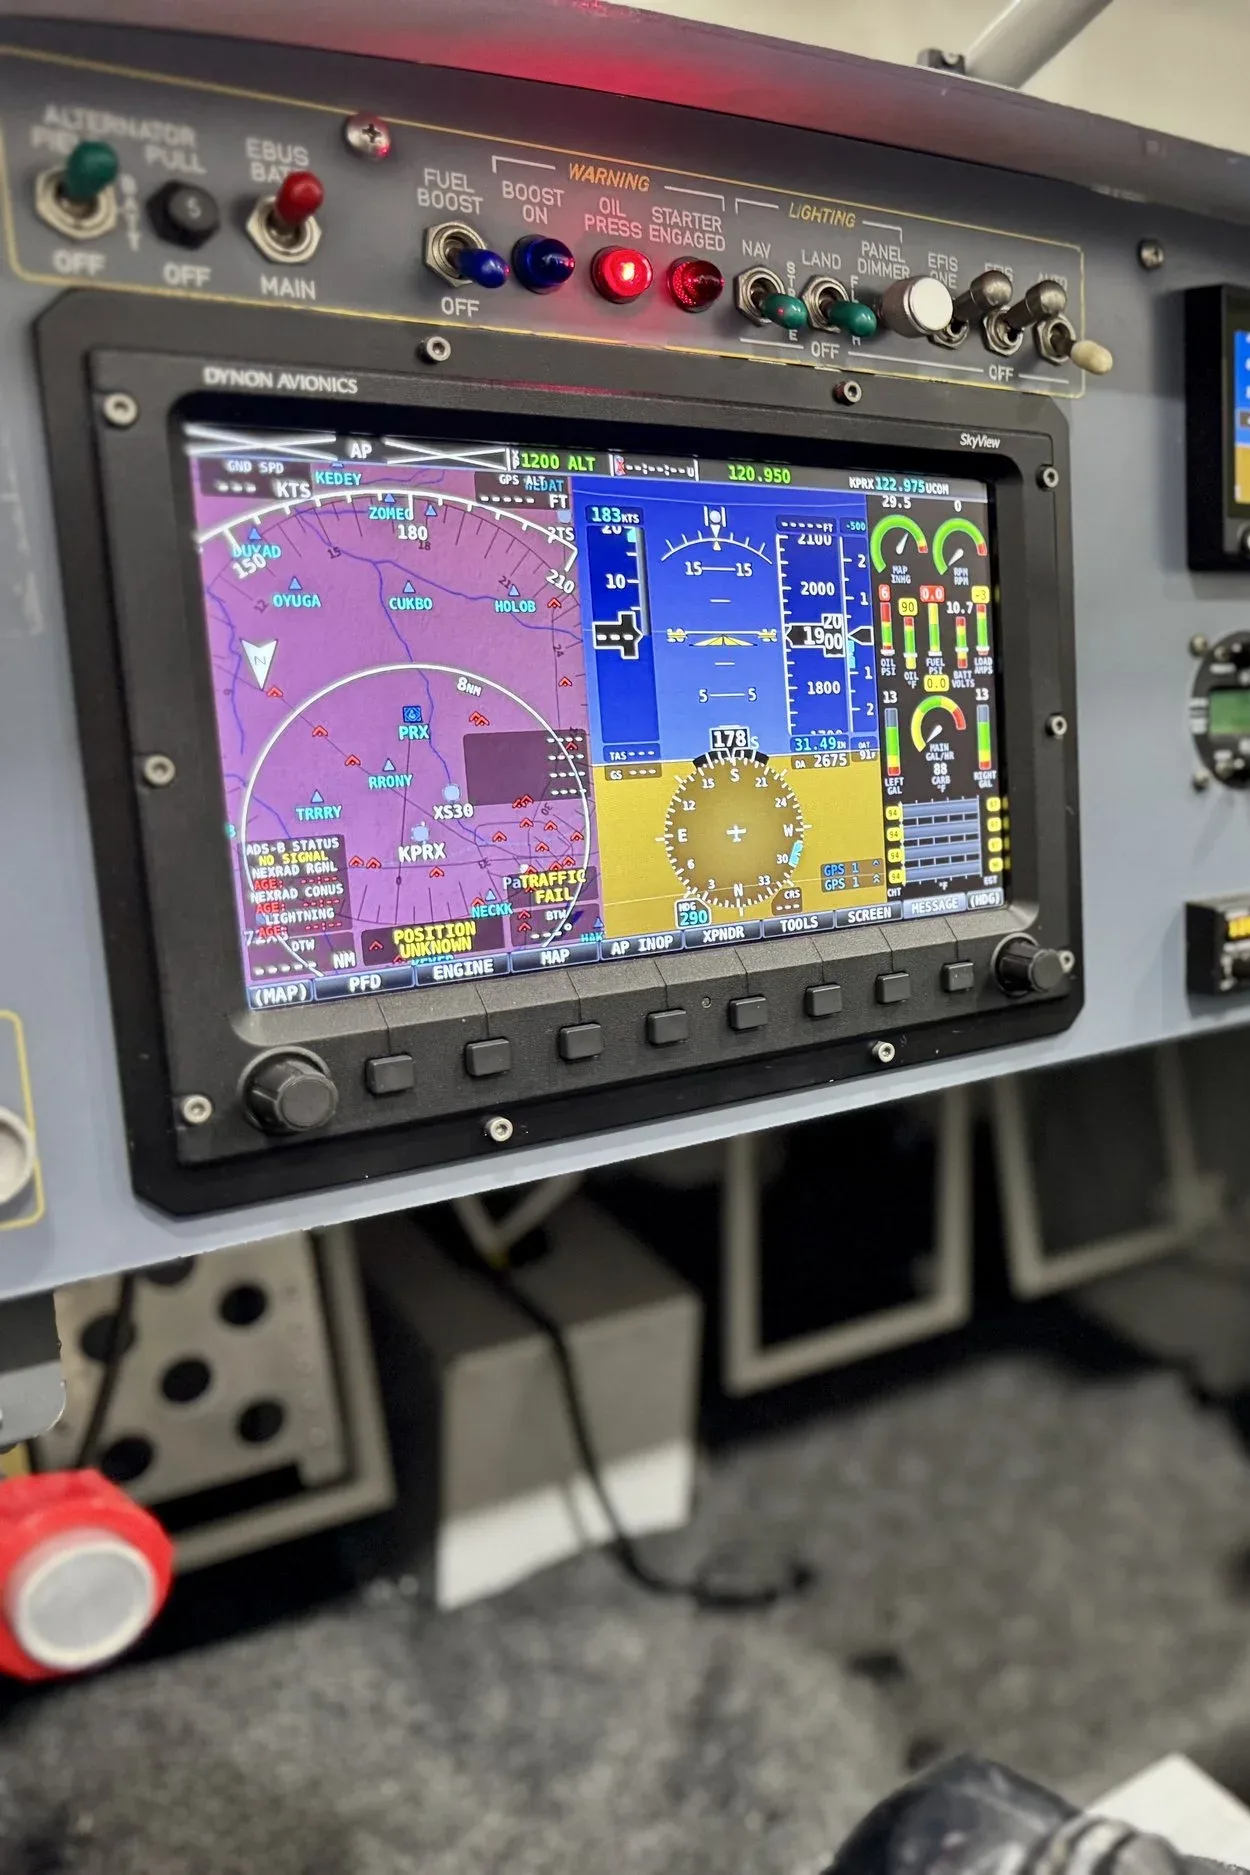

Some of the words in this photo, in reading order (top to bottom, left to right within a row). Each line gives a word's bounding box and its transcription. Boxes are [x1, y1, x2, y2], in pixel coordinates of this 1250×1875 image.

[44, 104, 196, 147] ALTERNATOR
[144, 143, 208, 175] PULL
[246, 137, 310, 167] EBUS
[424, 168, 475, 193] FUEL
[569, 163, 650, 193] WARNING
[417, 188, 483, 215] BOOST
[502, 180, 565, 207] BOOST
[522, 204, 548, 225] ON
[599, 197, 626, 217] OIL
[651, 206, 722, 233] STARTER
[789, 204, 856, 229] LIGHTING
[584, 214, 642, 239] PRESS
[649, 224, 726, 251] ENGAGED
[742, 239, 771, 260] NAV
[861, 240, 906, 263] PANEL
[53, 250, 105, 277] OFF
[802, 249, 841, 270] LAND
[928, 251, 959, 272] EFIS
[163, 261, 211, 287] OFF
[857, 258, 911, 280] DIMMER
[260, 273, 316, 299] MAIN
[441, 297, 480, 317] OFF
[811, 341, 841, 359] OFF
[203, 366, 273, 388] DYNON
[277, 373, 359, 394] AVIONICS
[988, 365, 1014, 382] OFF
[960, 433, 1000, 449] SkyView
[350, 442, 373, 460] AP
[226, 461, 252, 473] GND
[258, 462, 284, 474] SPD
[521, 453, 560, 470] 1200
[567, 455, 596, 471] ALT
[315, 471, 362, 486] KEDEY
[499, 475, 520, 485] GPS
[728, 465, 791, 484] 120.950
[275, 482, 312, 498] KTS
[849, 477, 874, 490] KPRX
[874, 476, 926, 493] 122.975
[549, 494, 568, 508] FT
[882, 495, 912, 509] 29.5
[954, 500, 962, 512] 0
[592, 507, 621, 522] 183
[621, 513, 640, 523] KTS
[398, 524, 428, 541] 180
[233, 553, 267, 579] 150
[685, 561, 702, 576] 15
[735, 562, 752, 577] 15
[857, 554, 867, 568] 2
[545, 569, 575, 594] 210
[606, 574, 626, 589] 10
[800, 581, 835, 596] 2000
[272, 594, 322, 608] OYUGA
[389, 598, 433, 610] CUKBO
[495, 600, 536, 613] HOLOB
[860, 592, 869, 606] 1
[901, 601, 915, 612] 90
[946, 601, 973, 614] 10.7
[864, 666, 873, 679] 1
[807, 681, 841, 695] 1800
[927, 678, 946, 689] 0.0
[883, 690, 898, 704] 13
[975, 688, 989, 701] 13
[866, 703, 875, 716] 2
[399, 725, 430, 740] PRX
[713, 730, 747, 748] 178
[794, 737, 837, 751] 31.49
[609, 751, 627, 761] TAS
[813, 753, 847, 767] 2675
[933, 762, 948, 775] 88
[368, 774, 413, 789] RRONY
[702, 778, 715, 789] 15
[755, 777, 768, 788] 21
[683, 800, 696, 811] 12
[775, 797, 787, 808] 24
[296, 805, 342, 821] TRRRY
[433, 803, 475, 820] XS30
[677, 828, 688, 842] E
[783, 824, 794, 837] W
[246, 842, 286, 855] ADS-B
[292, 837, 339, 852] STATUS
[398, 842, 446, 863] KPRX
[258, 856, 275, 867] NO
[282, 850, 328, 864] SIGNAL
[687, 859, 695, 869] 6
[776, 853, 789, 864] 30
[252, 865, 300, 879] NEXRAD
[306, 861, 338, 874] RGNL
[520, 869, 586, 888] TRAFFIC
[823, 864, 845, 878] GPS
[852, 863, 859, 874] 1
[708, 879, 716, 890] 3
[758, 875, 771, 886] 33
[824, 877, 845, 891] GPS
[853, 877, 860, 888] 1
[250, 888, 298, 903] NEXRAD
[304, 883, 344, 898] CONUS
[535, 887, 574, 904] FAIL
[733, 883, 743, 897] N
[912, 899, 959, 916] MESSAGE
[970, 892, 1001, 908] (HDG)
[265, 908, 335, 926] LIGHTNING
[471, 902, 514, 919] NECKK
[680, 911, 708, 927] 290
[848, 906, 892, 923] SCREEN
[394, 921, 476, 944] POSITION
[780, 916, 819, 932] TOOLS
[703, 926, 745, 943] XPNDR
[399, 936, 471, 959] UNKNOWN
[611, 941, 630, 956] AP
[638, 935, 673, 951] INOP
[333, 951, 356, 968] NM
[541, 948, 570, 966] MAP
[433, 958, 494, 980] ENGINE
[349, 974, 382, 992] PFD
[255, 984, 307, 1006] (MAP)
